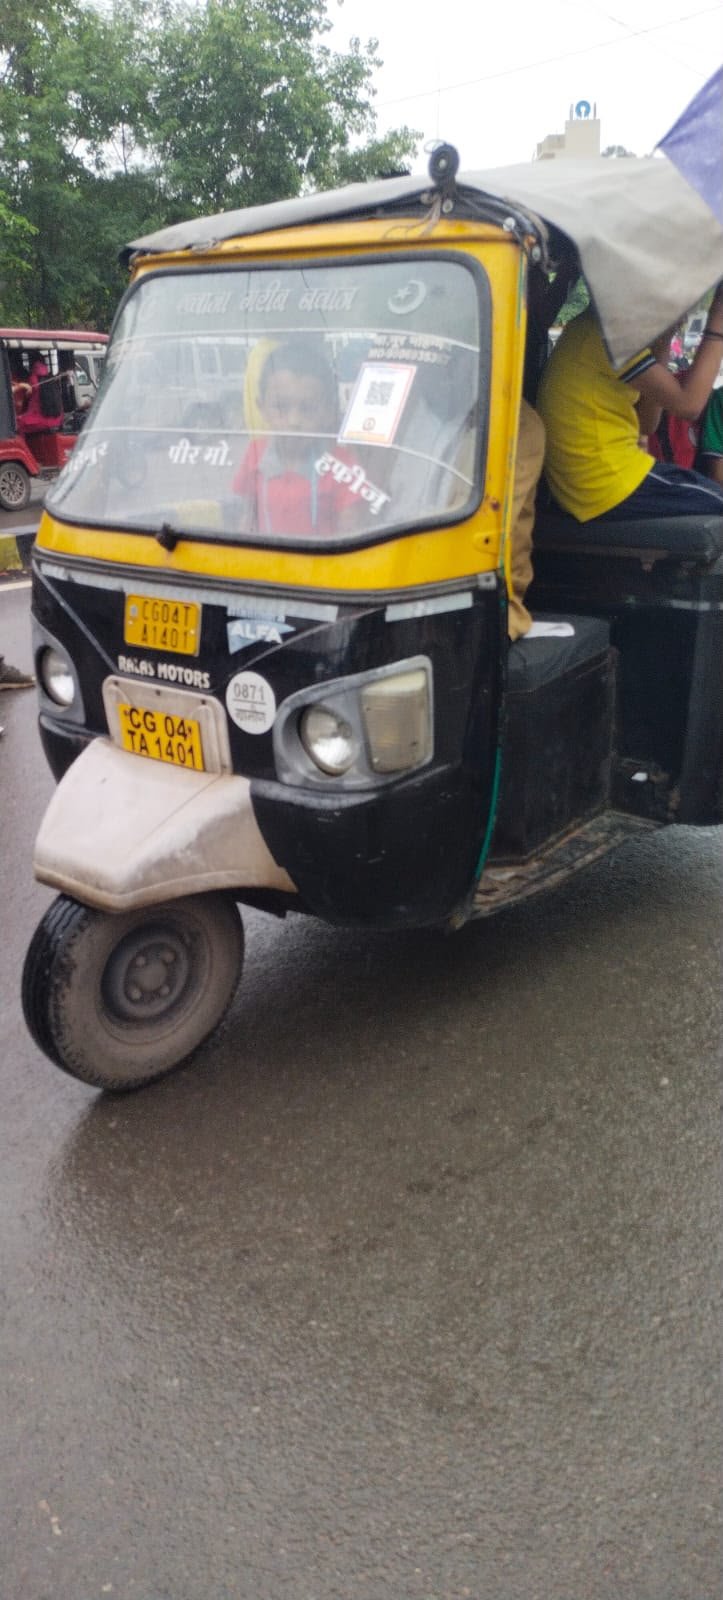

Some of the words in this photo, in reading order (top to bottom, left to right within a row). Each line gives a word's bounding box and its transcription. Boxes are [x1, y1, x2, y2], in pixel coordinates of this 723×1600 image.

[168, 437, 202, 465] पीर
[142, 600, 191, 627] CG04T
[141, 623, 188, 649] A1401
[229, 622, 283, 645] ALFA
[157, 662, 211, 689] MOTORS
[233, 682, 265, 701] 0871
[129, 707, 157, 732] CG
[164, 715, 187, 741] 04
[127, 729, 150, 756] TA
[155, 736, 195, 768] 1401
